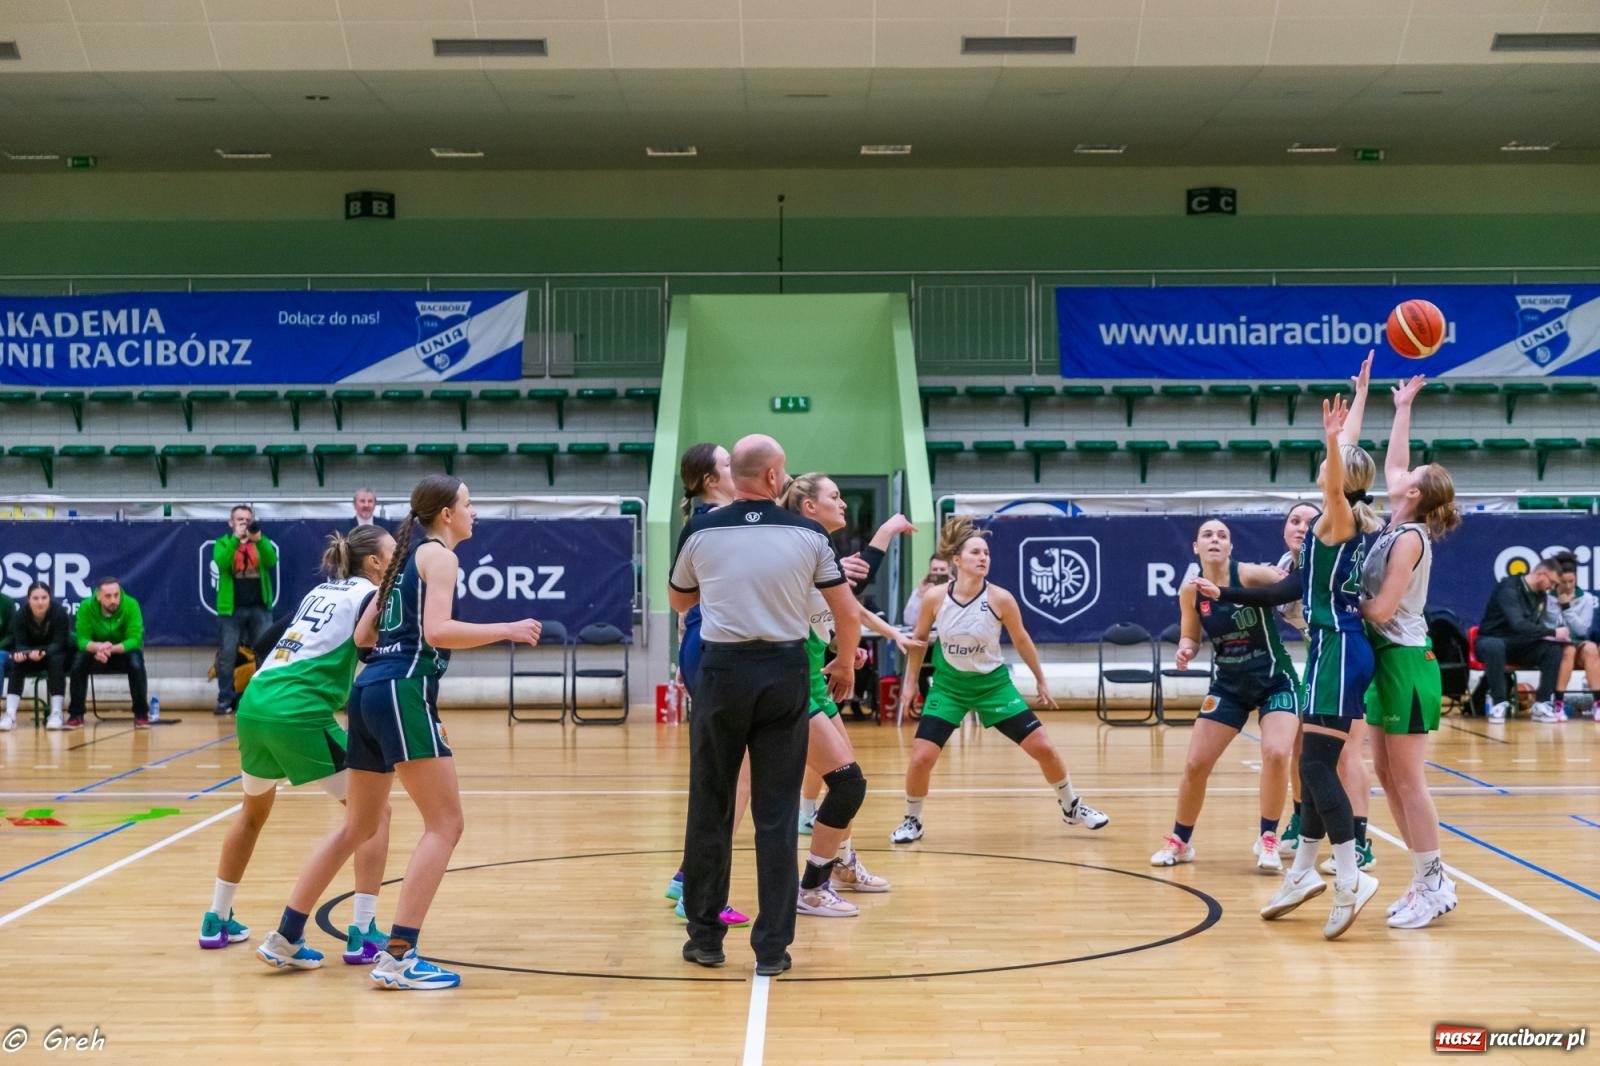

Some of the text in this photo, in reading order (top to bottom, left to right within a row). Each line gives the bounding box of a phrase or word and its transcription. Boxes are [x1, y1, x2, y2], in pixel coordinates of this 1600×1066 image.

[350, 201, 361, 216] B
[372, 200, 389, 215] B
[278, 310, 380, 328] Dołącz do nas!
[420, 327, 463, 354] UNIA
[1521, 320, 1564, 348] UNIA
[69, 332, 252, 369] RACIBÓRZ
[0, 552, 92, 598] SiR
[289, 594, 336, 633] 14
[1231, 607, 1258, 630] 10
